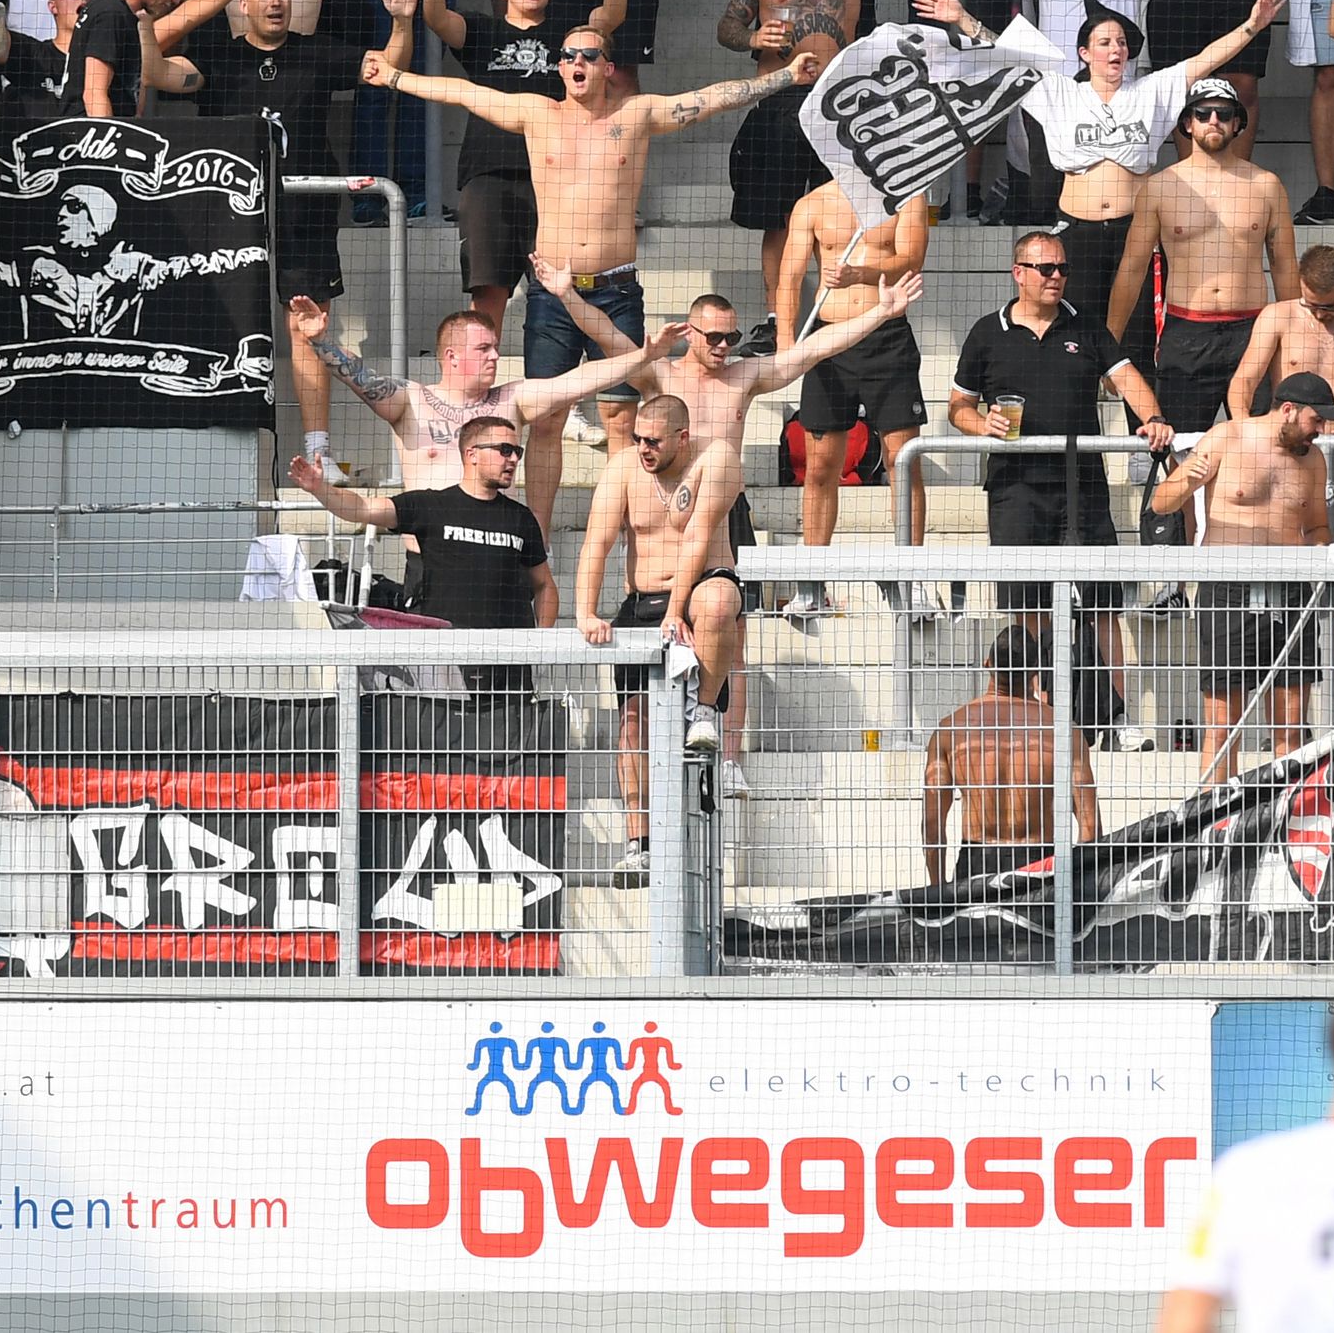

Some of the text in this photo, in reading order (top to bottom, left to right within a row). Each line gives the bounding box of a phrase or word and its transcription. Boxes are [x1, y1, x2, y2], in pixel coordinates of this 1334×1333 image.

[58, 127, 120, 161] Adi
[177, 158, 235, 187] 2016
[148, 351, 188, 374] Seite
[443, 525, 485, 545] FREE
[708, 1067, 1167, 1094] elektro-technik
[365, 1137, 1198, 1258] obwegeser
